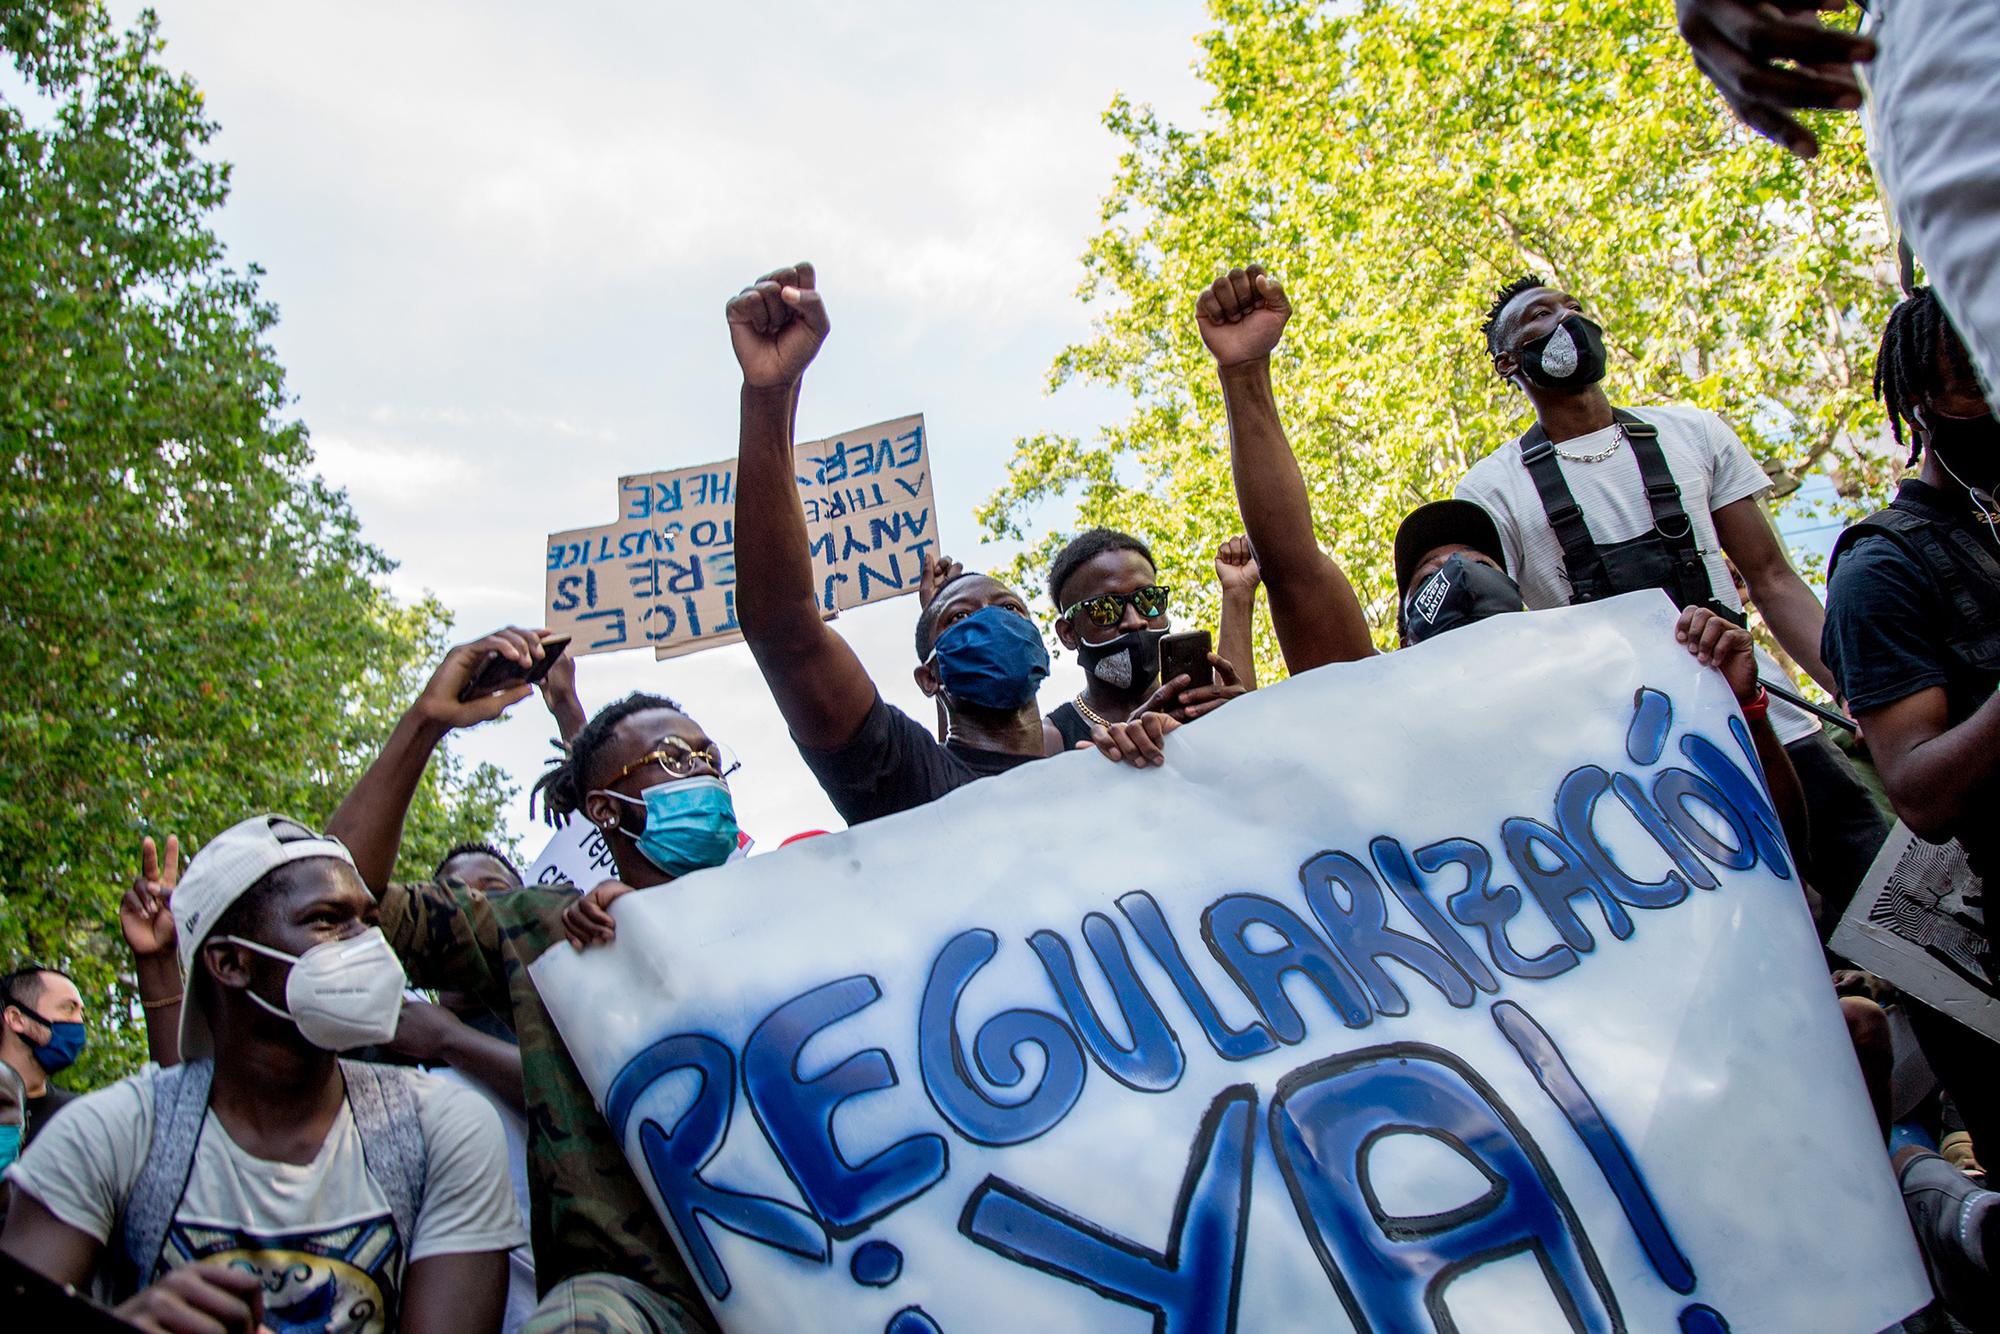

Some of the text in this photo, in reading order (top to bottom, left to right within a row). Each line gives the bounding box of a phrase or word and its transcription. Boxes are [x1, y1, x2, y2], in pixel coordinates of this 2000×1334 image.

[546, 471, 926, 571] A THRE TO JUSTICE
[622, 424, 923, 520] EVERHERE
[552, 507, 929, 612] ANYWERE IS
[575, 538, 933, 648] INJTICE
[1424, 582, 1440, 608] LIVES
[1425, 581, 1447, 619] MATTER
[605, 685, 1791, 1300] REGULARIZACIÓN
